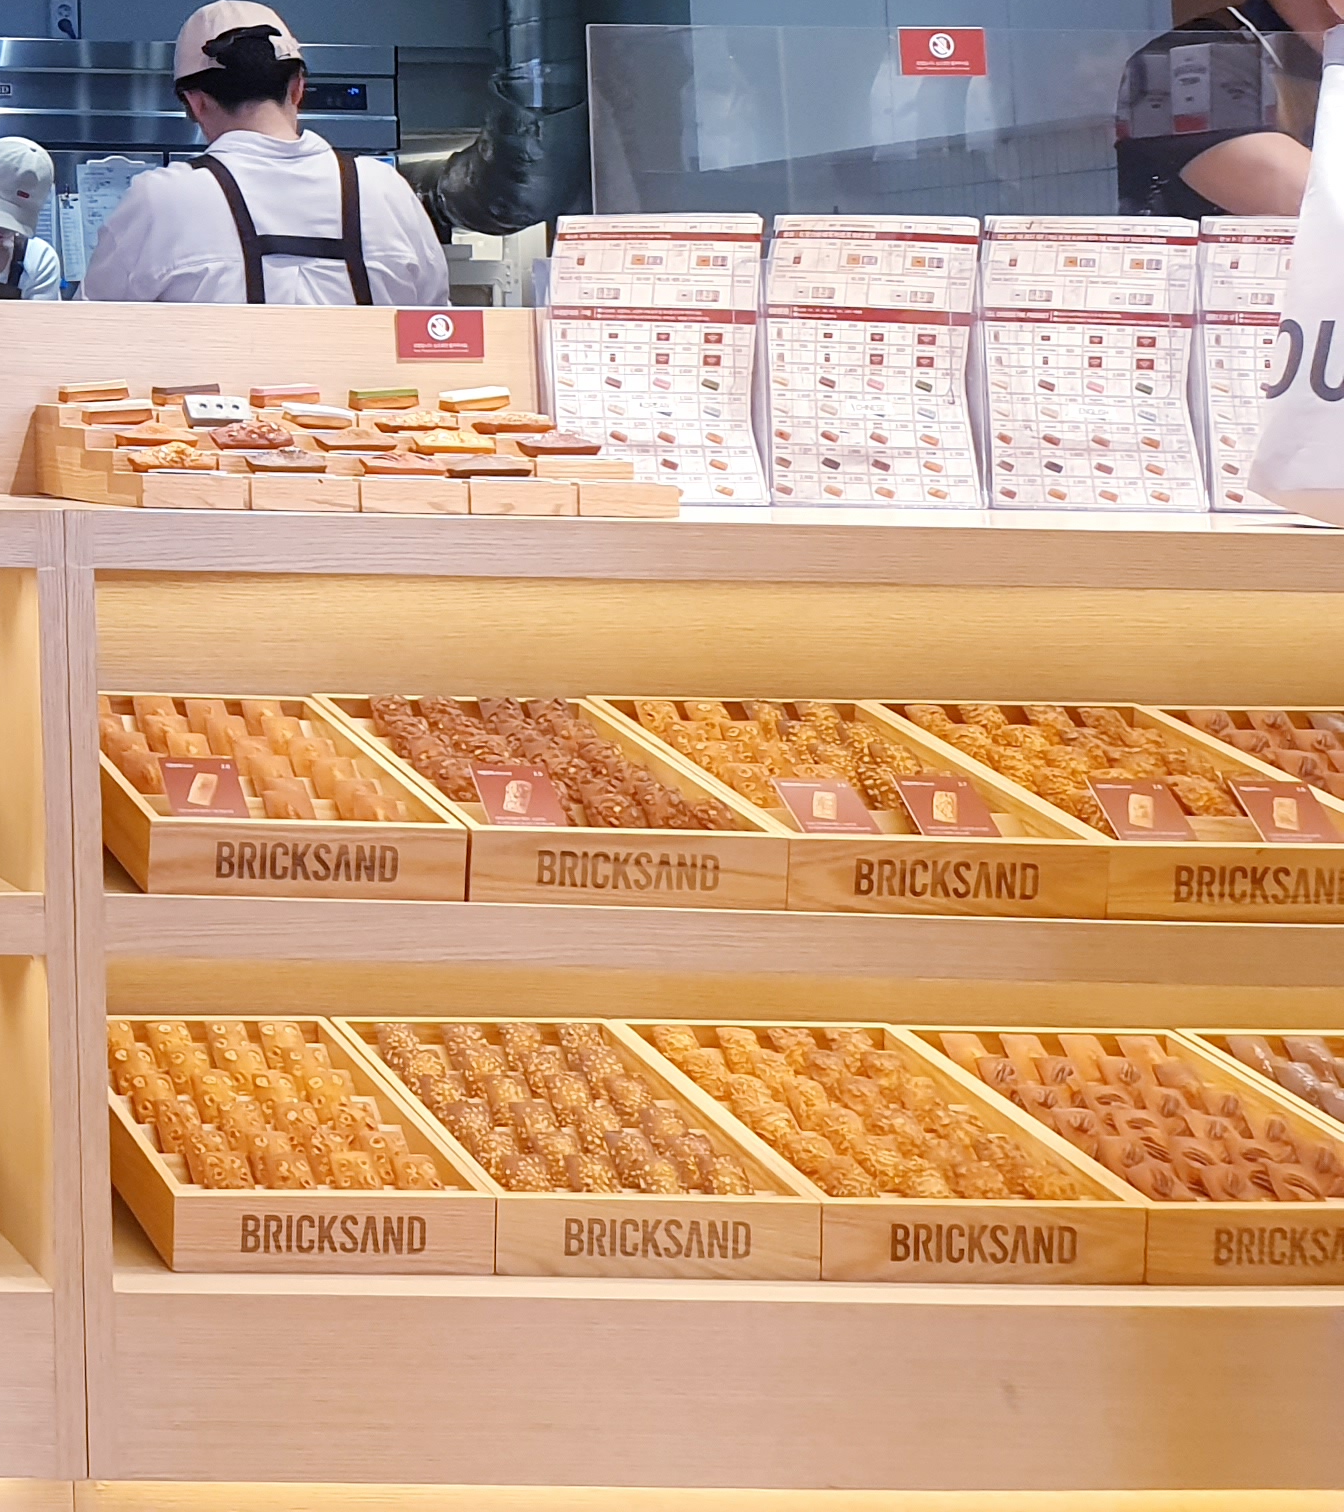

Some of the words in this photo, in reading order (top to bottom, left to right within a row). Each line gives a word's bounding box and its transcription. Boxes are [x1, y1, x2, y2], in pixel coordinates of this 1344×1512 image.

[216, 842, 398, 883] BRICKSAND
[537, 850, 720, 891] BRICKSAND
[854, 859, 1040, 901] BRICKSAND
[240, 1215, 426, 1254] BRICKSAND
[564, 1217, 751, 1260] BRICKSAND
[890, 1224, 1078, 1264] BRICKSAND
